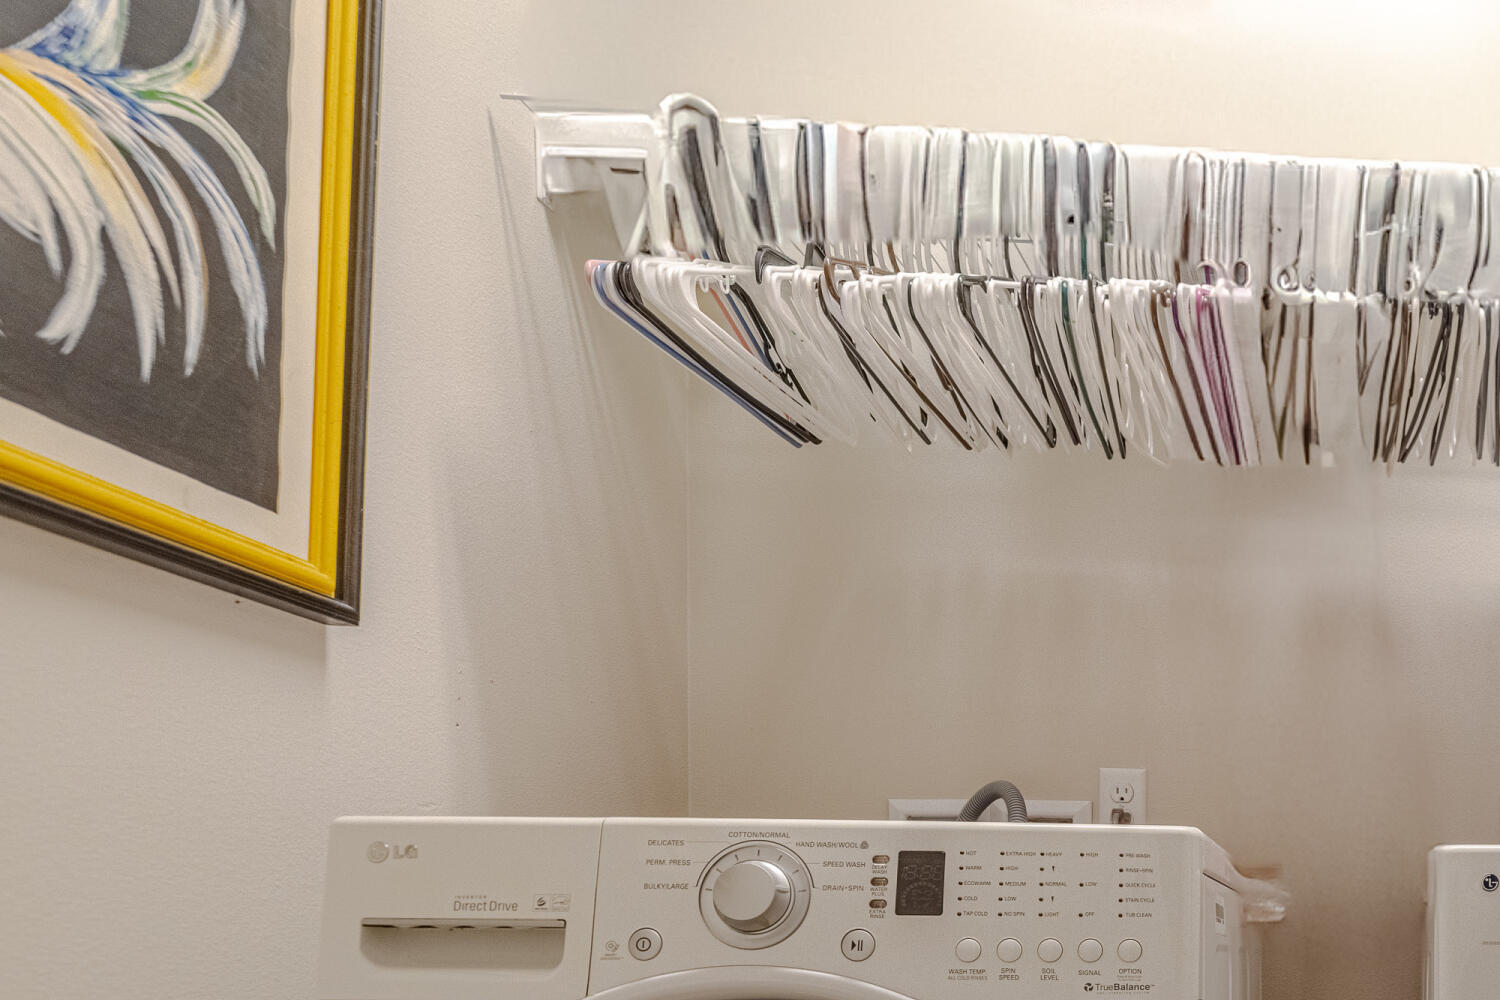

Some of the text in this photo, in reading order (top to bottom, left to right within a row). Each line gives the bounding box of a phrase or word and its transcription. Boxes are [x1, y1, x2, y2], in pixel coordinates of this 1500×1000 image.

[728, 831, 790, 839] COTTON/NORMAL
[391, 844, 418, 859] LG
[453, 900, 518, 912] Direct Drive
